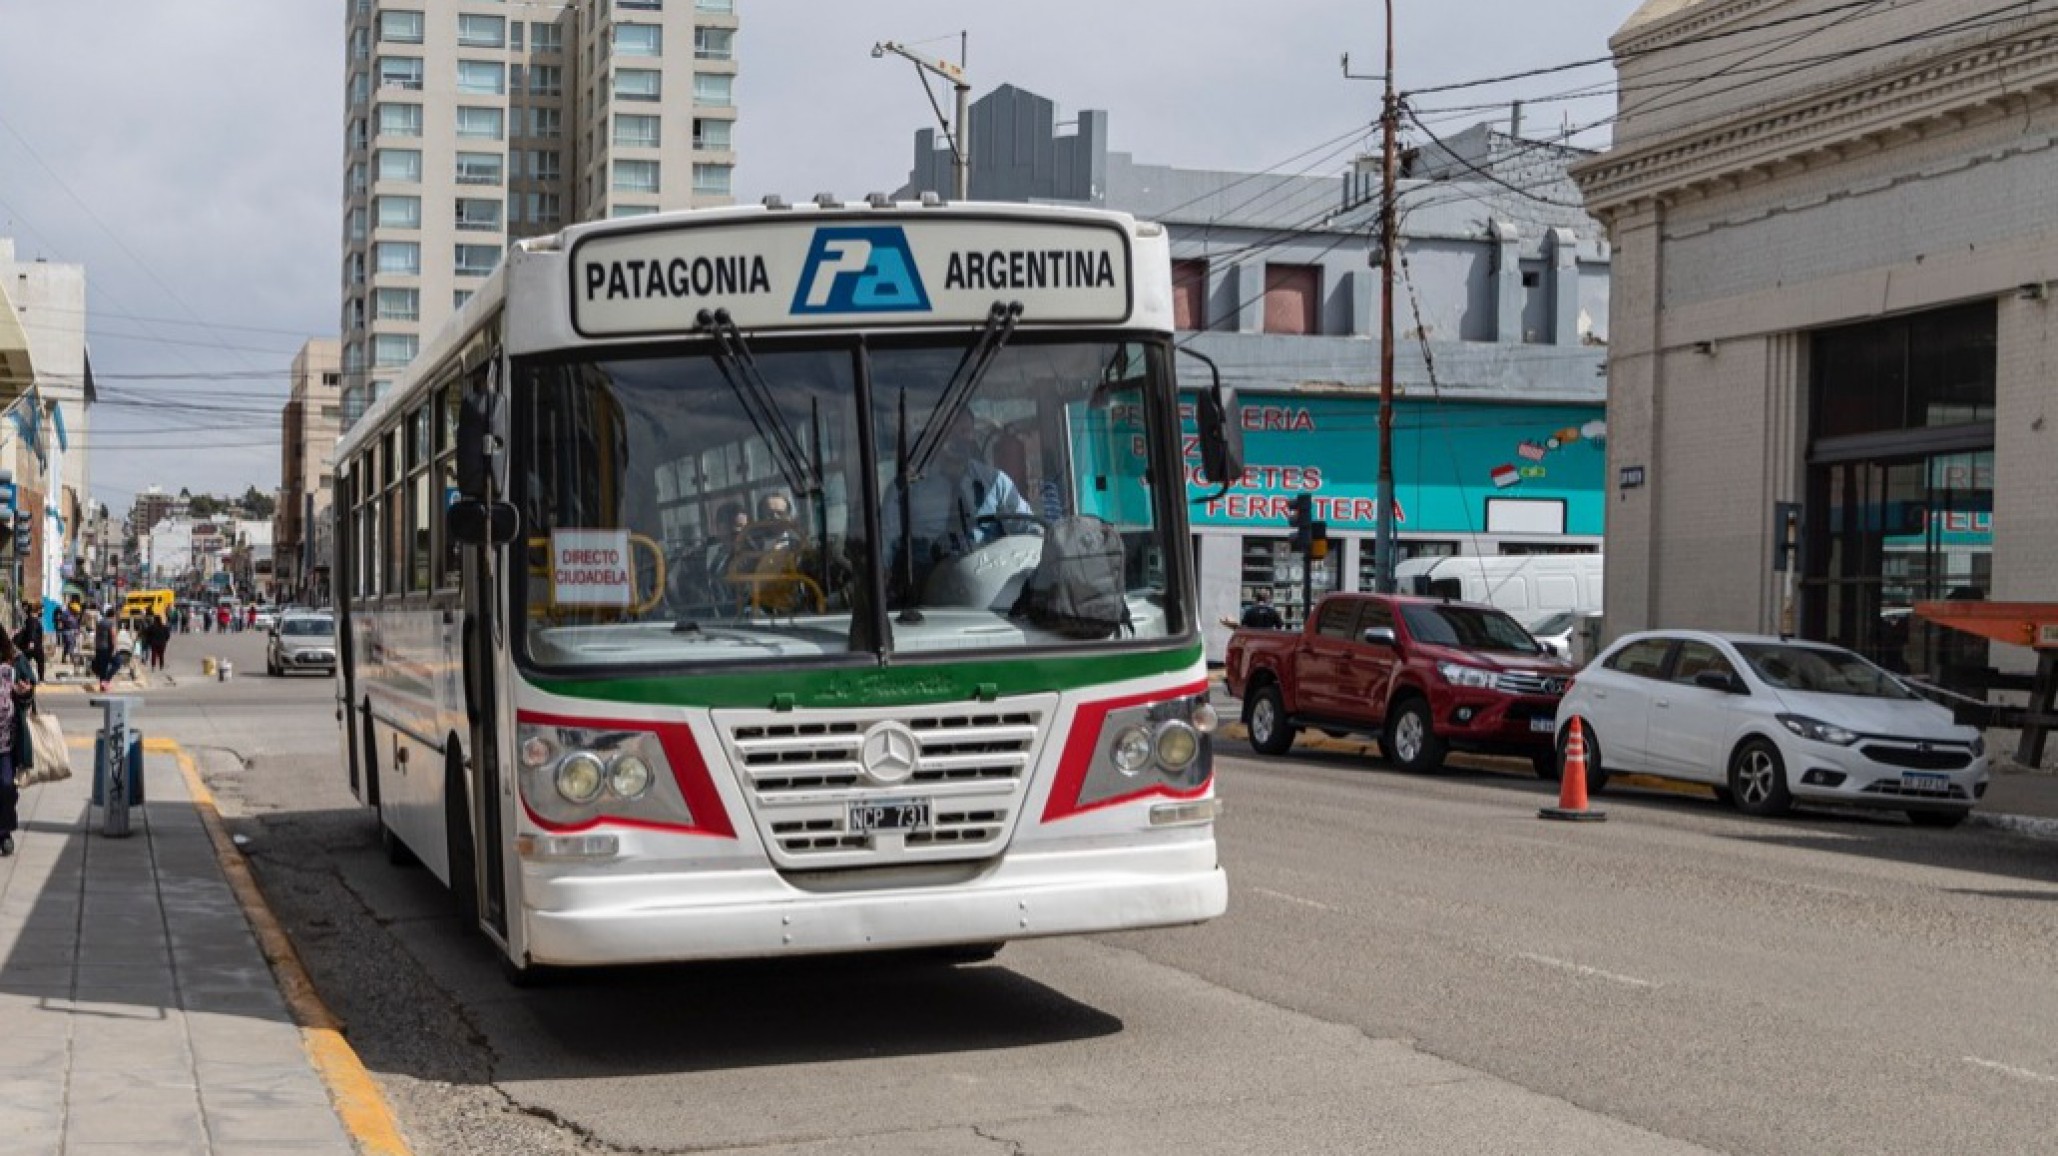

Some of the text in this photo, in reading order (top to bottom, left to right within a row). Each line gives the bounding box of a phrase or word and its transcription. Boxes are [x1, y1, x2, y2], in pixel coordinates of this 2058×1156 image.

[586, 254, 771, 301] PATAGONIA
[945, 249, 1115, 290] ARGENTINA
[562, 548, 620, 565] DIRECTO
[556, 568, 628, 585] CIUDADELA
[849, 804, 926, 830] NCP 731
